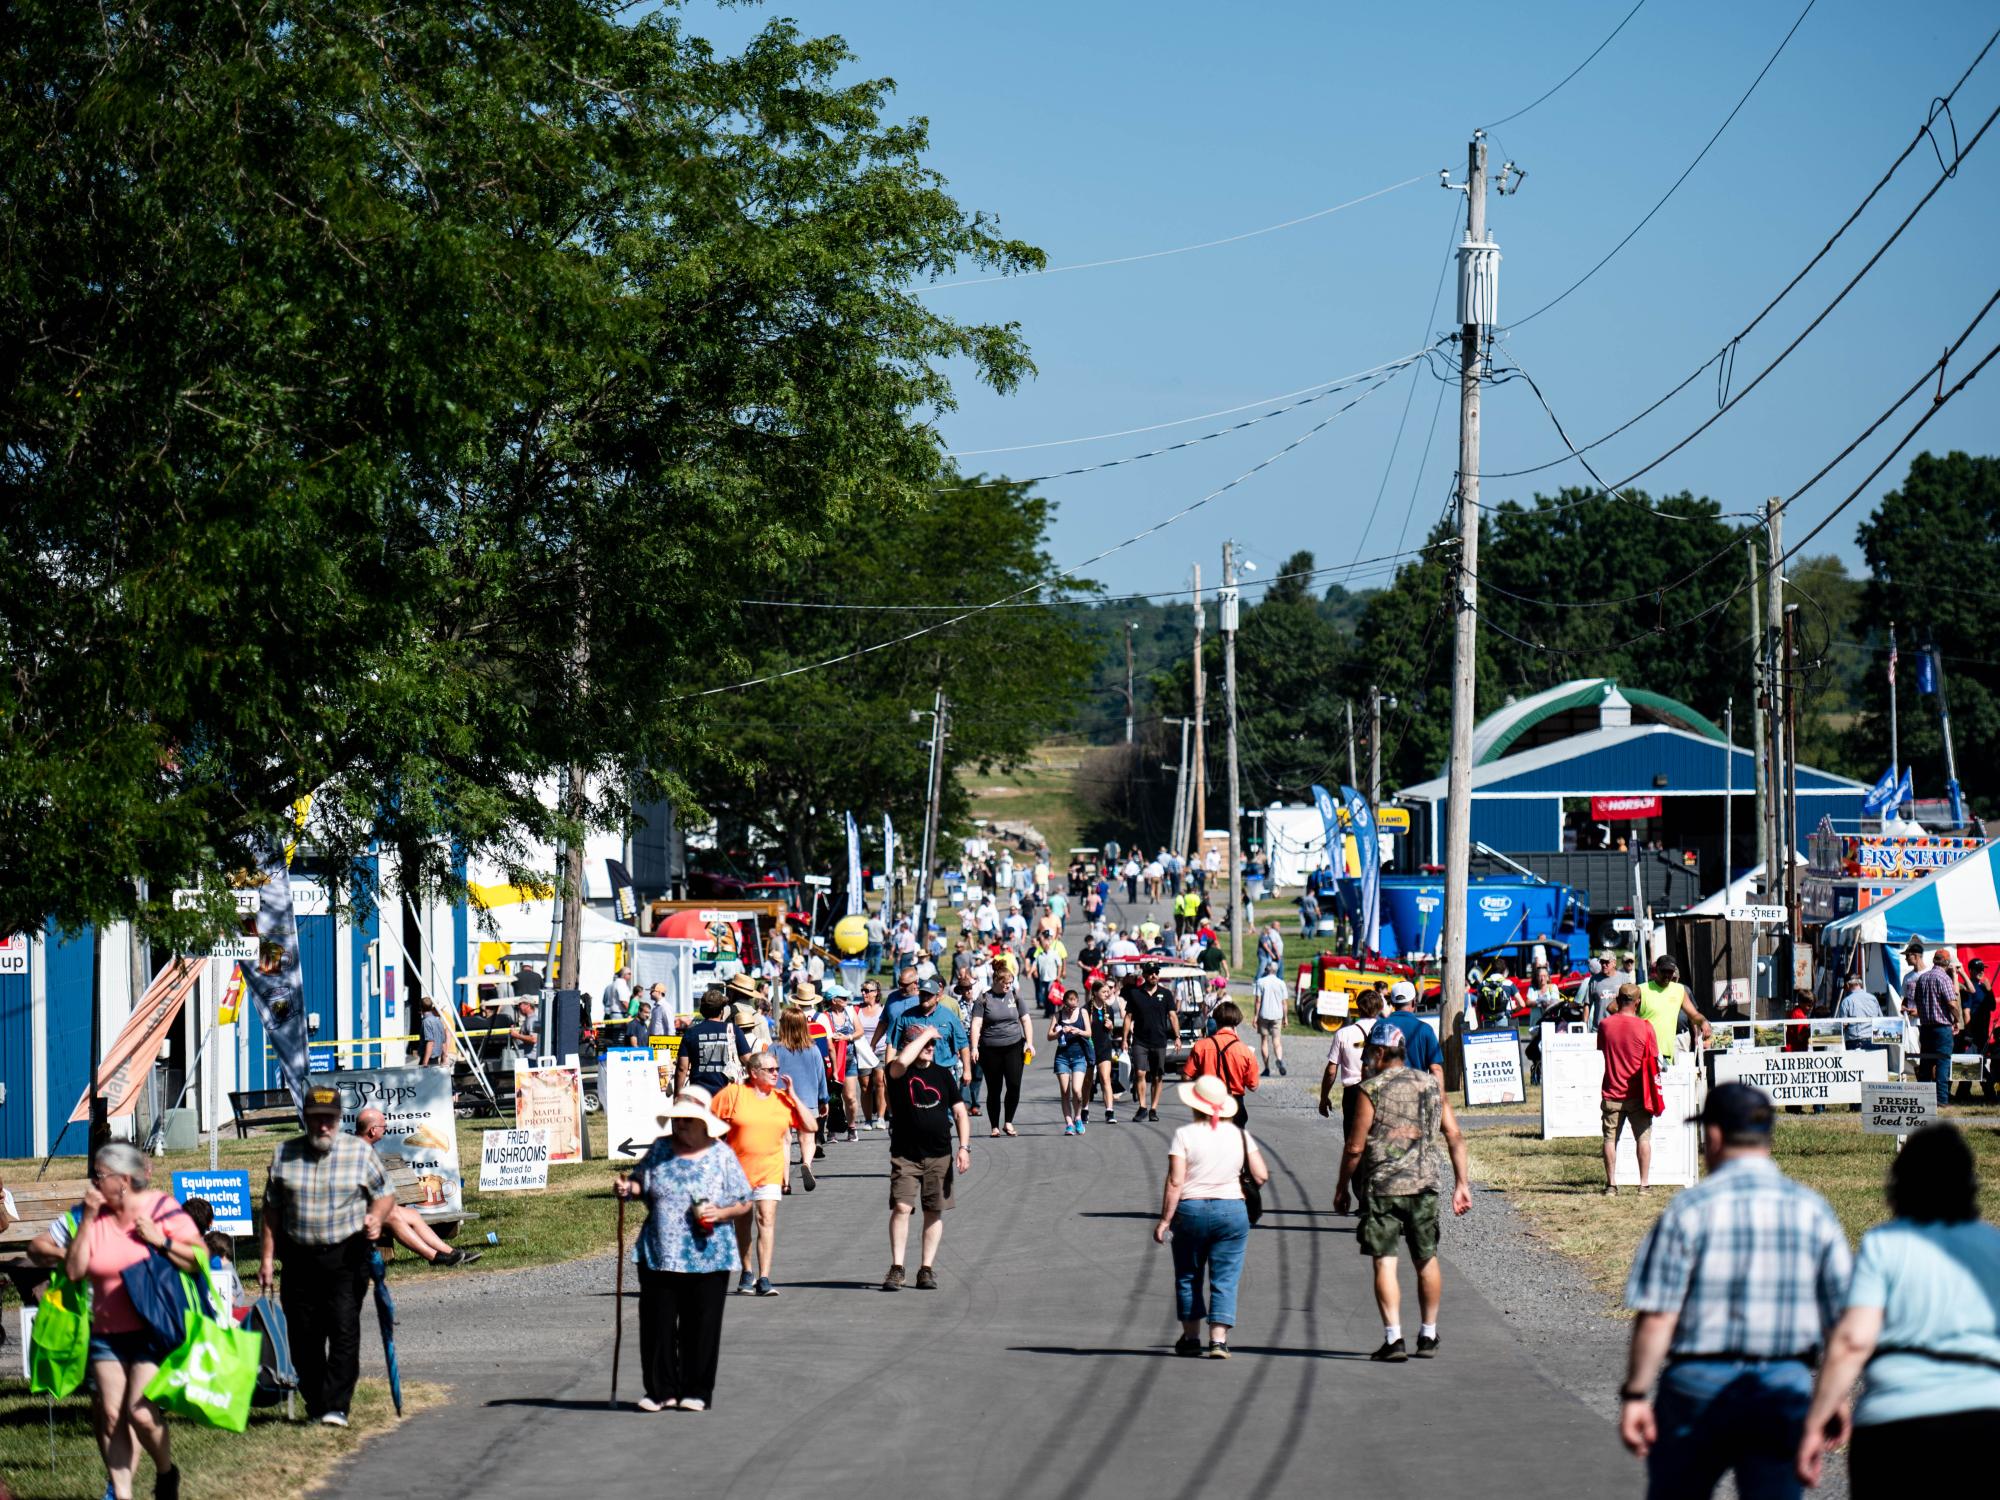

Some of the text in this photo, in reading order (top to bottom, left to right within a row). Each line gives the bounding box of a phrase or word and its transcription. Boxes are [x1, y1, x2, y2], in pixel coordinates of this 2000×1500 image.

[1859, 848, 1898, 869] FRY
[1751, 909, 1781, 918] STREET
[1473, 1060, 1512, 1070] FARM
[1765, 1056, 1843, 1071] FAIRBROOK
[1473, 1068, 1514, 1078] SHOW
[1738, 1070, 1864, 1087] UNITED METHODIST
[1472, 1076, 1517, 1085] MILKSHAKES
[1772, 1086, 1829, 1099] CHURCH
[1878, 1097, 1919, 1106] FRESH
[533, 1108, 563, 1116] MAPLE
[1872, 1104, 1926, 1114] BREWED
[525, 1115, 573, 1126] PRODUCTS
[1872, 1115, 1929, 1127] Iced Tea
[506, 1130, 530, 1145] FRIED
[485, 1145, 547, 1164] MUSHROOMS
[499, 1165, 532, 1174] Moved to
[181, 1176, 242, 1191] Equipment
[480, 1174, 546, 1187] West 2nd & Main St
[186, 1191, 240, 1204] Financing
[212, 1205, 242, 1216] lable!
